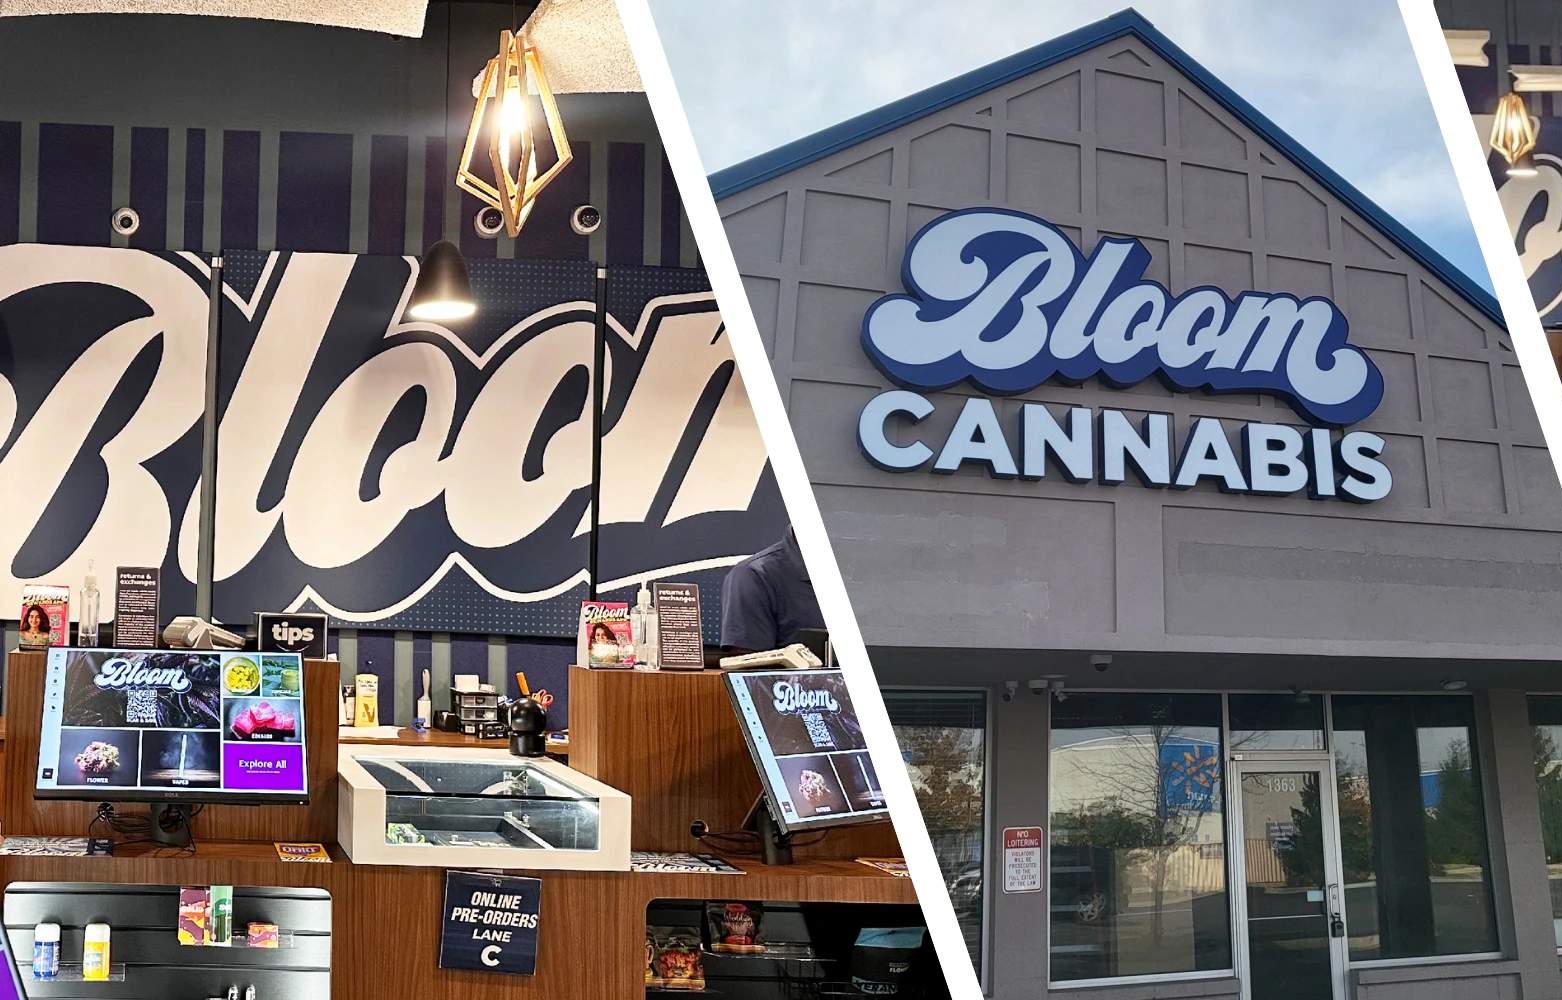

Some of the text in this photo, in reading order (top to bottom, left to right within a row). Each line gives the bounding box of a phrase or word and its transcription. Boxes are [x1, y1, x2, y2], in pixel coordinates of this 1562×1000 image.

[868, 212, 1369, 406] Bloom
[857, 389, 1394, 502] CANNABIS
[120, 579, 157, 587] exchanges
[584, 604, 630, 620] Bloom
[271, 622, 315, 646] tips
[94, 658, 192, 693] Bloom
[773, 682, 840, 713] Bloom
[239, 759, 287, 769] Explore All
[1267, 778, 1296, 792] 1363
[1007, 838, 1039, 847] LOITERING
[471, 891, 522, 910] ONLINE
[451, 907, 539, 928] PRE-ORDERS
[472, 928, 513, 942] LANE
[481, 944, 502, 967] C
